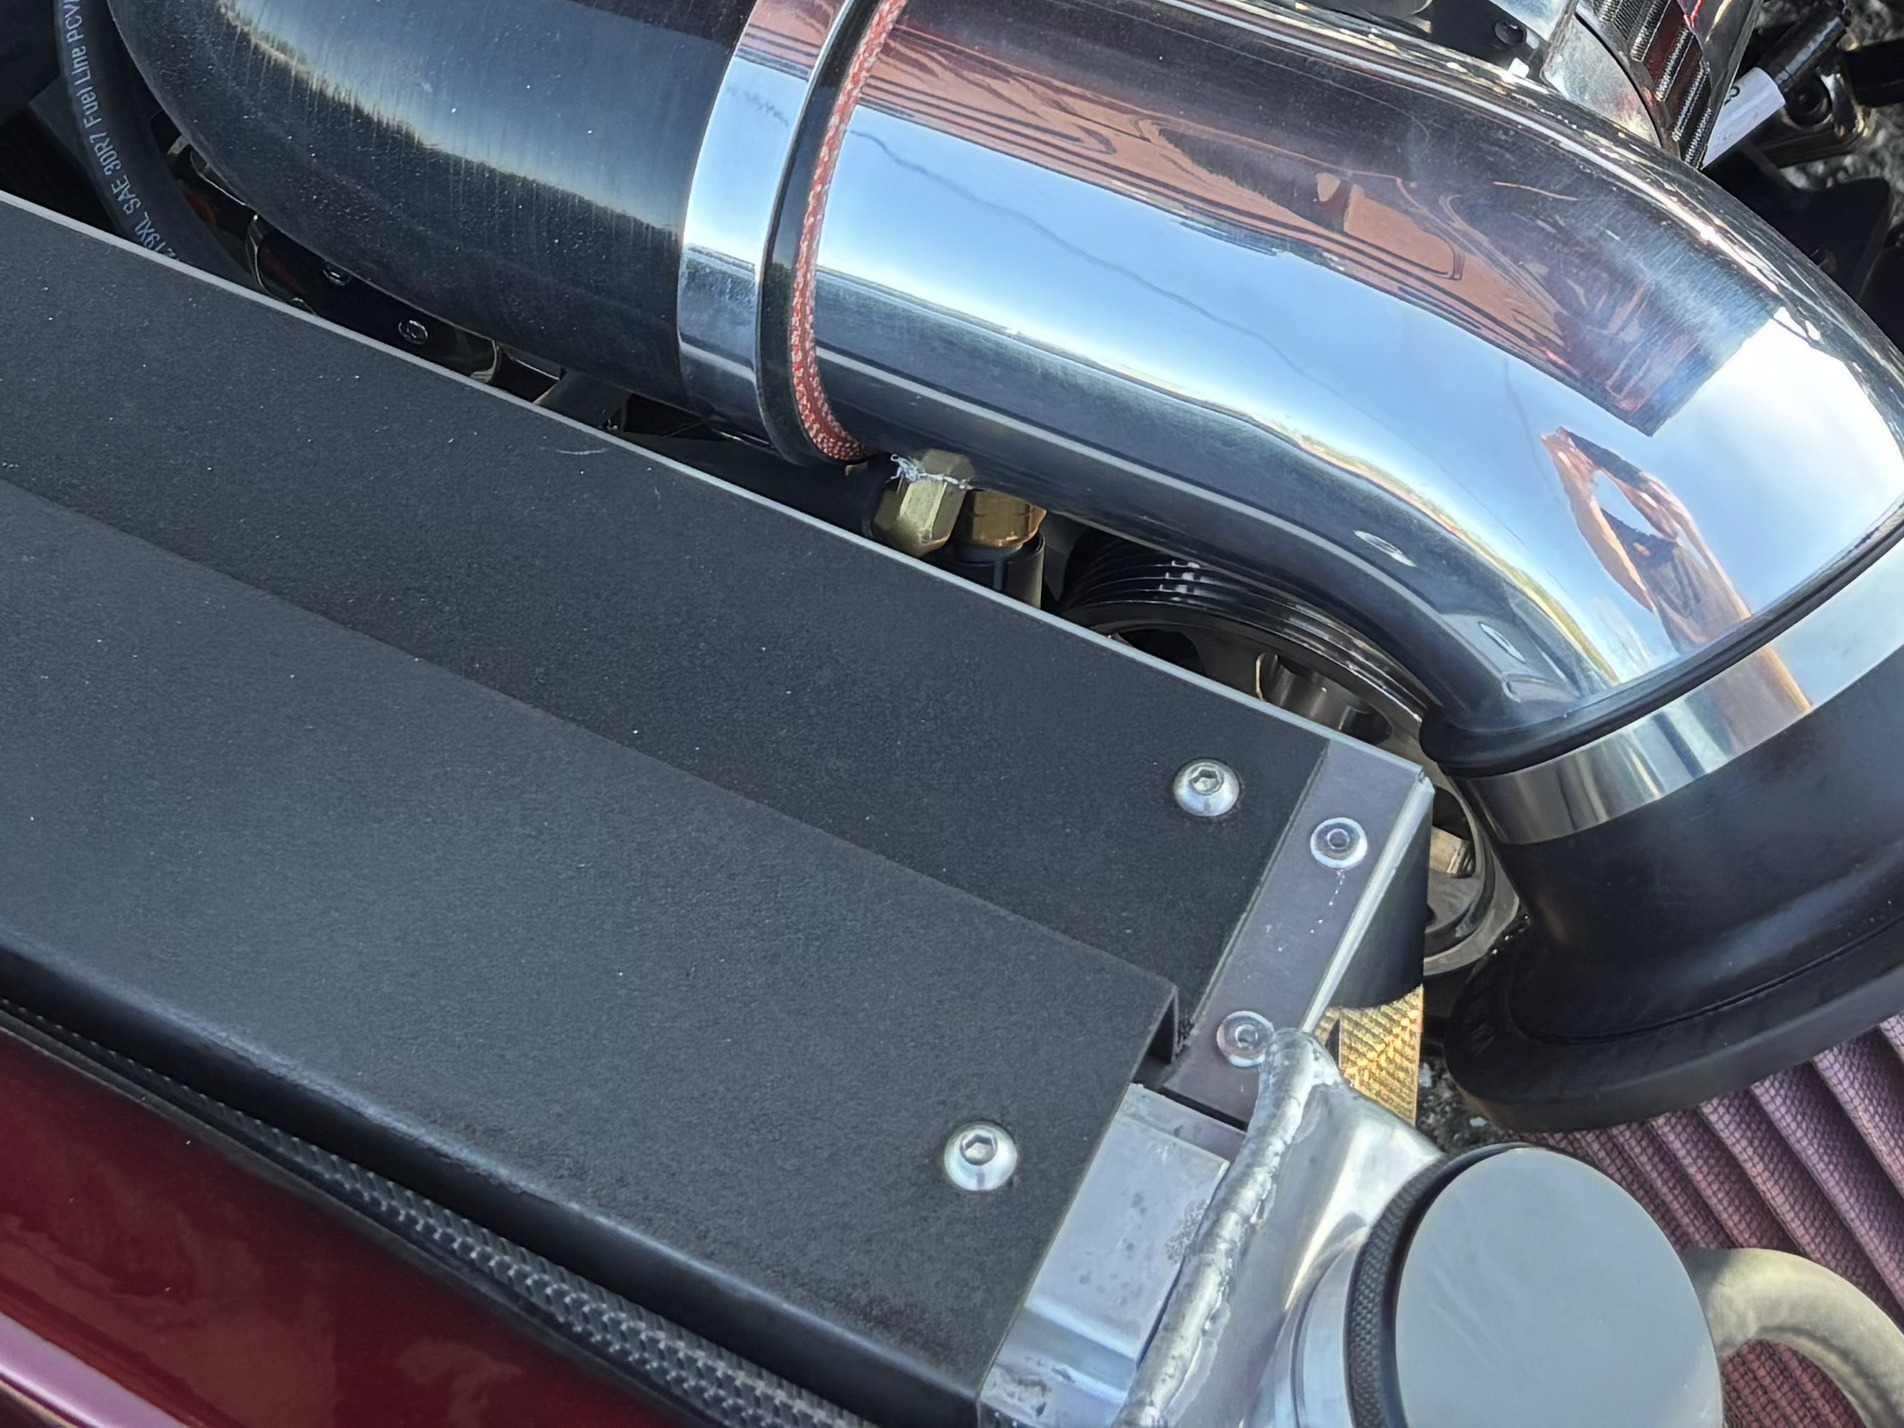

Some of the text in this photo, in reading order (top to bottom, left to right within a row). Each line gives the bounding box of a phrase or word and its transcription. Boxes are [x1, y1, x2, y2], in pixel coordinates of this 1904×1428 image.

[71, 44, 91, 86] Line
[76, 86, 102, 129] Fuel
[89, 132, 122, 175] 30R7
[111, 175, 142, 215] SAE
[133, 211, 180, 262] 19XL
